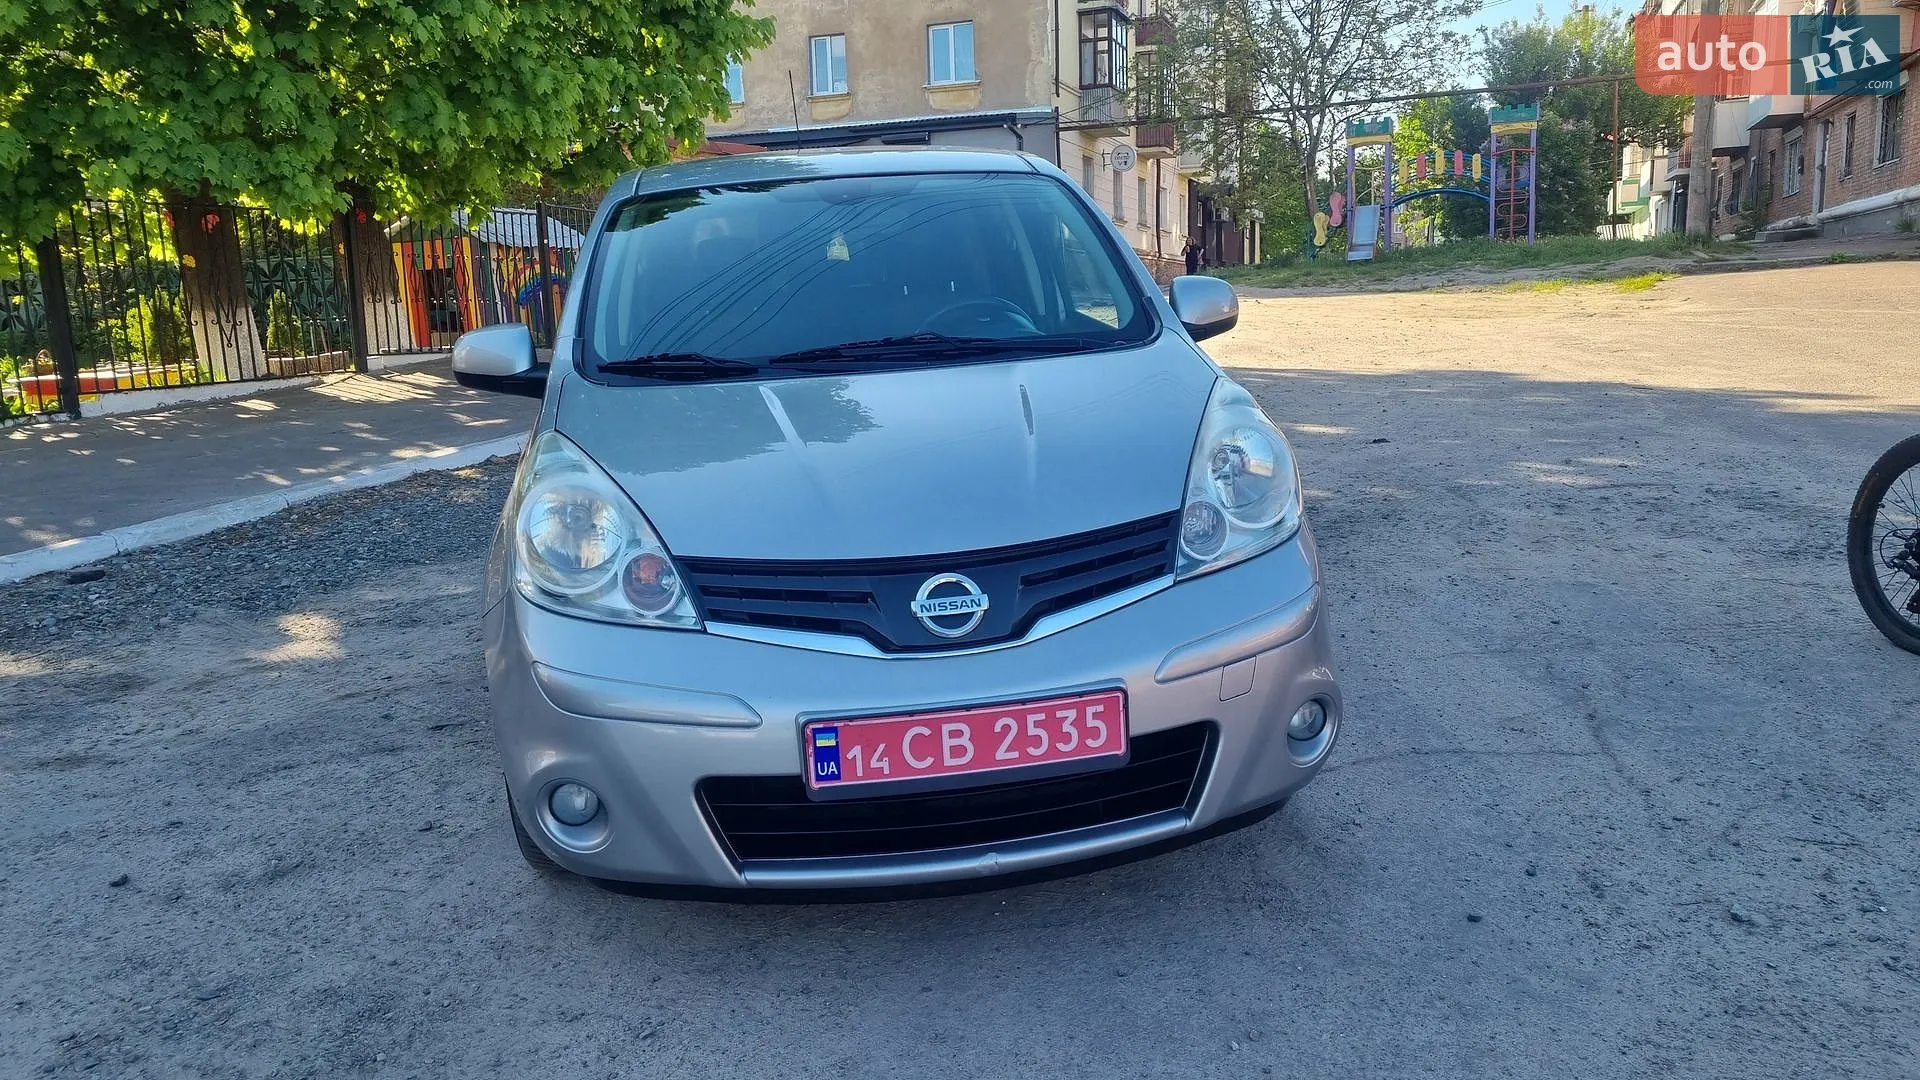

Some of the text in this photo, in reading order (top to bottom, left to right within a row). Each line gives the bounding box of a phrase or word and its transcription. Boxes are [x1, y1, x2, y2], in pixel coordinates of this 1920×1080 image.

[920, 598, 982, 613] NISSAN
[846, 704, 1108, 777] 14 CB 2535
[817, 761, 839, 776] UA
